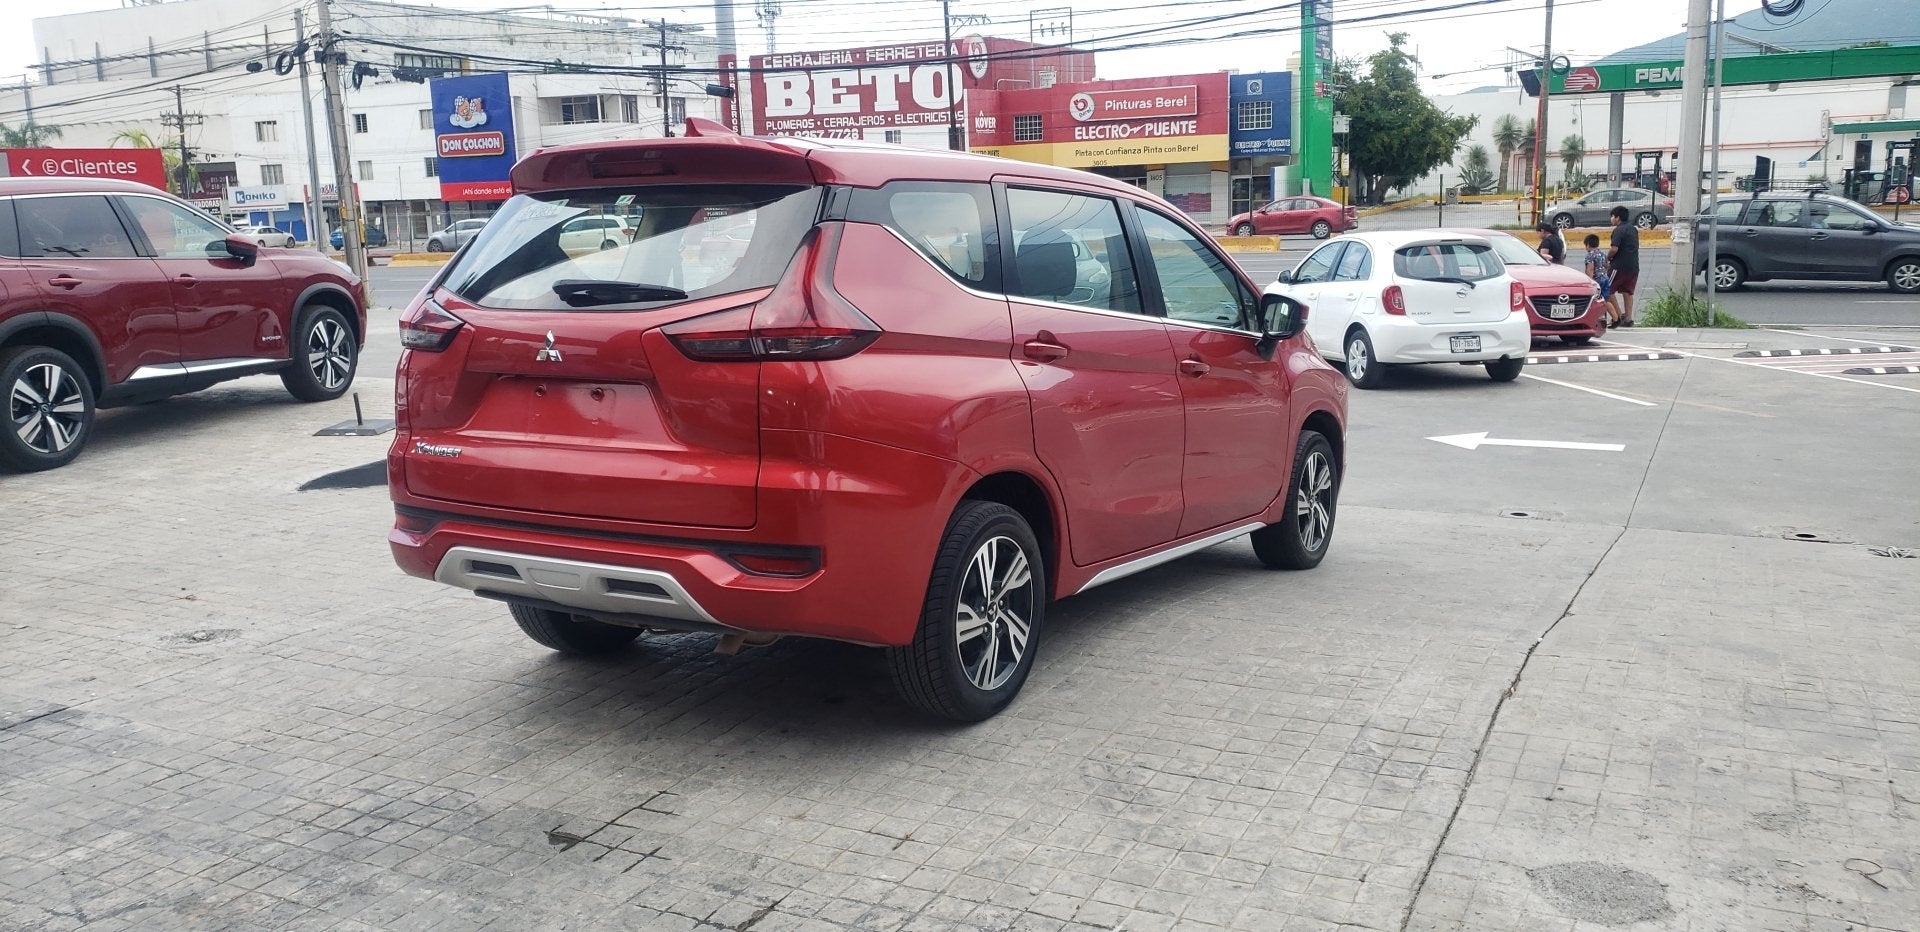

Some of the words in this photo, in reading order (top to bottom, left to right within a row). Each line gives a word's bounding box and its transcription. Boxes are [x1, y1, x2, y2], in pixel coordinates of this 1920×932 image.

[865, 42, 959, 61] FERRETERA
[1635, 66, 1685, 84] PEM
[763, 62, 963, 117] BETO
[1105, 99, 1152, 111] Pinturas
[1155, 95, 1187, 108] Berel
[766, 119, 815, 130] PLOMEROS
[823, 115, 885, 128] CERRAJEROS
[1074, 124, 1130, 140] ELECTRO
[1145, 120, 1197, 136] PUENTE
[441, 139, 461, 152] DON
[463, 137, 500, 151] COLCHON
[1075, 149, 1092, 157] Pinta
[1105, 146, 1142, 156] Confianza
[1143, 145, 1162, 154] Pinta
[1177, 144, 1199, 153] Berel
[61, 159, 138, 175] Clientes
